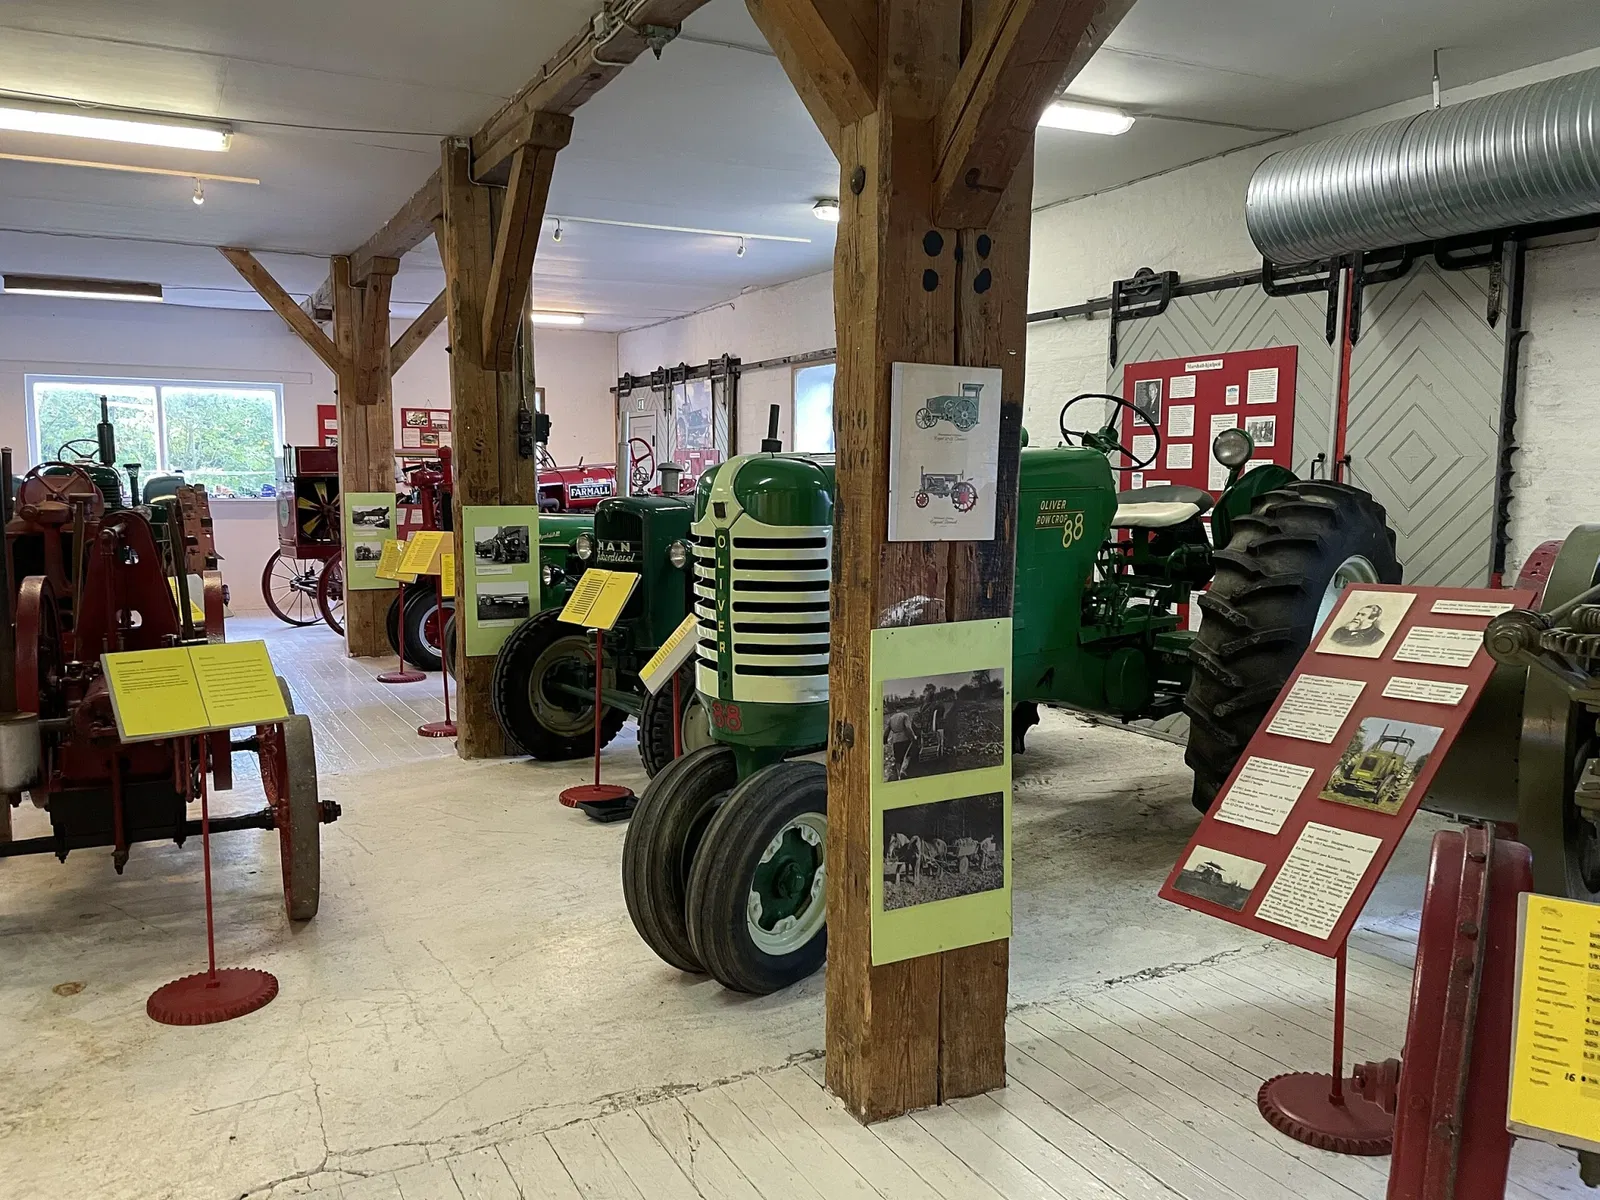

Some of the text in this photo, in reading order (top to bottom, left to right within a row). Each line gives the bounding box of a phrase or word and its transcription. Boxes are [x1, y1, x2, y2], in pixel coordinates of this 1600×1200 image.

[571, 486, 610, 496] FARMALL
[1040, 500, 1067, 510] OLIVER
[1062, 514, 1084, 548] 88
[717, 535, 726, 653] OLIVER
[712, 702, 742, 731] 88
[1564, 1072, 1576, 1082] 16
